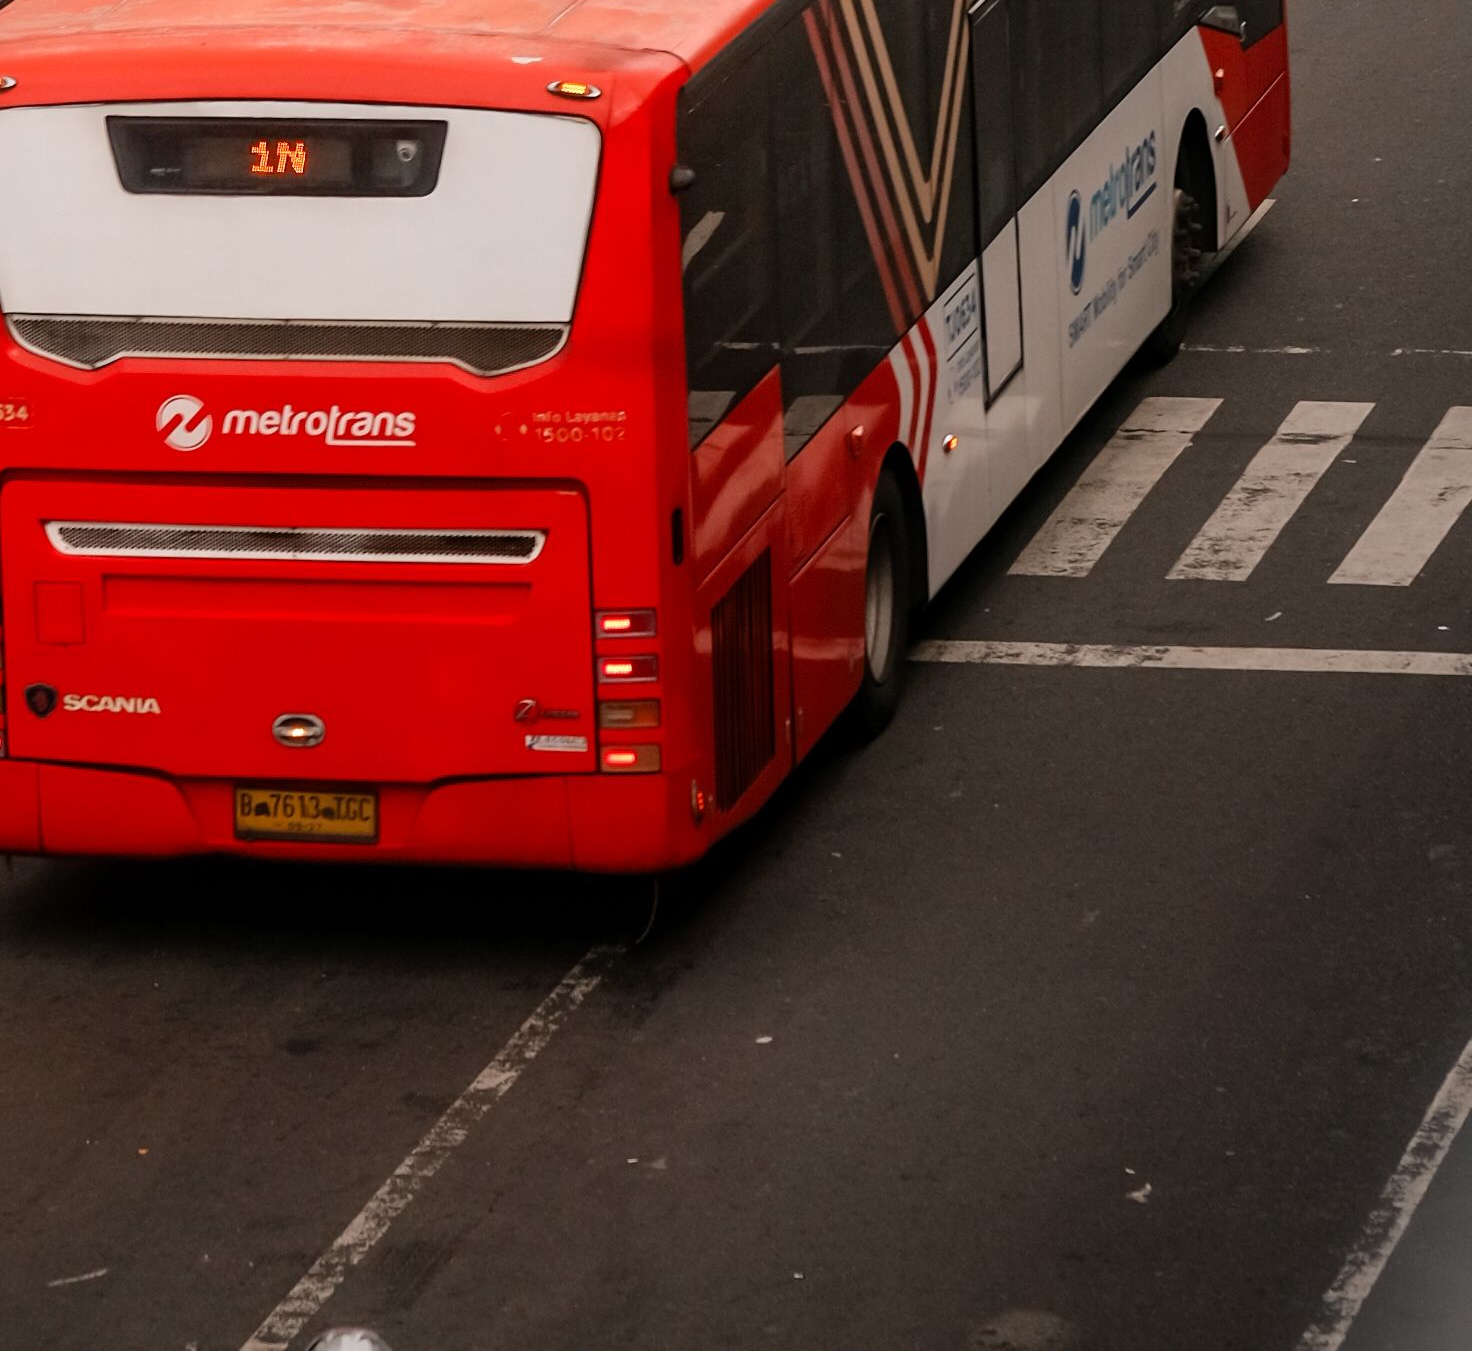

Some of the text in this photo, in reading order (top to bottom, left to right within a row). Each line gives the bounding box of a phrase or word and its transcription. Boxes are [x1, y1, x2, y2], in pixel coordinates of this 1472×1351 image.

[250, 141, 306, 174] 1N
[221, 404, 416, 446] metrotrans
[63, 694, 161, 714] SCANIA
[240, 793, 253, 817] B
[269, 794, 320, 819] 7613
